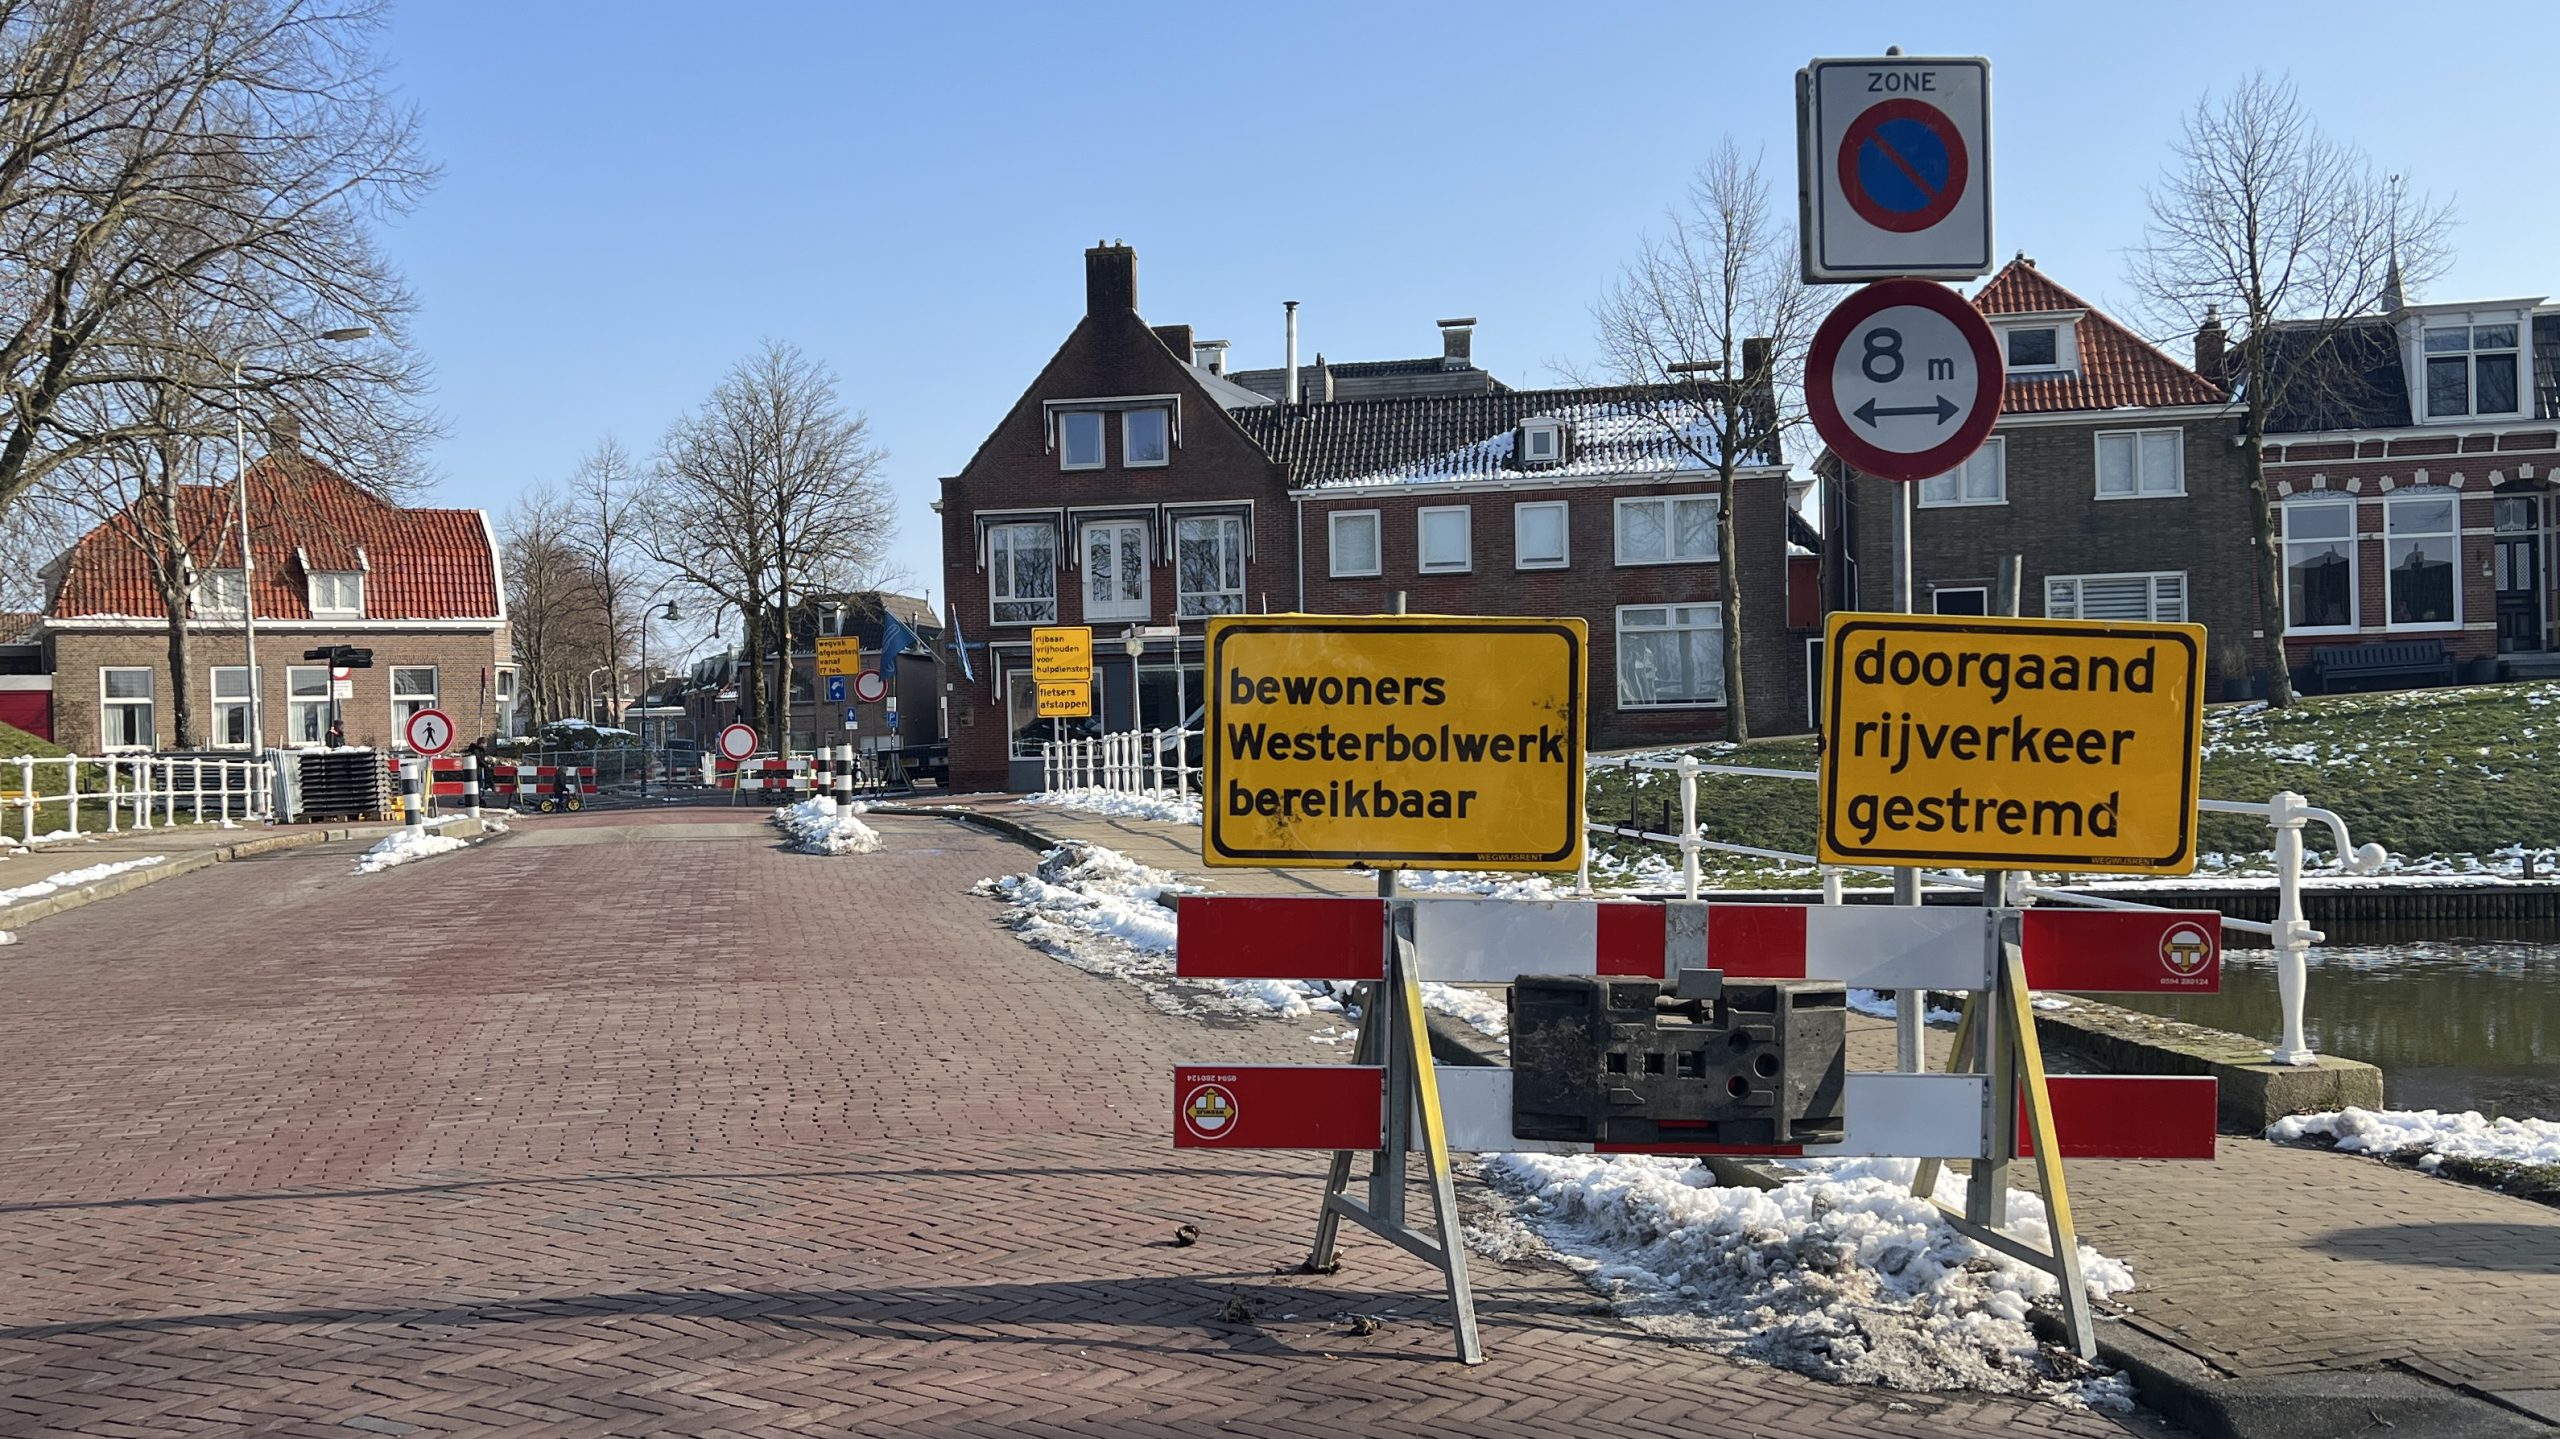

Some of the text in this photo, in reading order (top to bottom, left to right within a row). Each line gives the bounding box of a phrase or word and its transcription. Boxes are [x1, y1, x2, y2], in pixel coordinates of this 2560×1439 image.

[1867, 72, 1936, 92] ZONE
[1861, 327, 1954, 383] 8 m
[1036, 636, 1064, 644] rijbaan
[1036, 645, 1079, 653] vrijhouden
[819, 648, 857, 656] afgesloten
[820, 657, 840, 665] vanaf
[1036, 665, 1089, 674] hulpdiensten
[1854, 636, 2156, 705] doorgaand
[1040, 688, 1076, 697] fietsers
[1230, 666, 1446, 706] bewoners
[1040, 700, 1088, 709] afstappen
[1227, 722, 1565, 764] Westerbolwerk
[1854, 711, 2135, 774] rijverkeer
[1229, 778, 1477, 819] bereikbaar
[1847, 787, 2120, 845] gestremd
